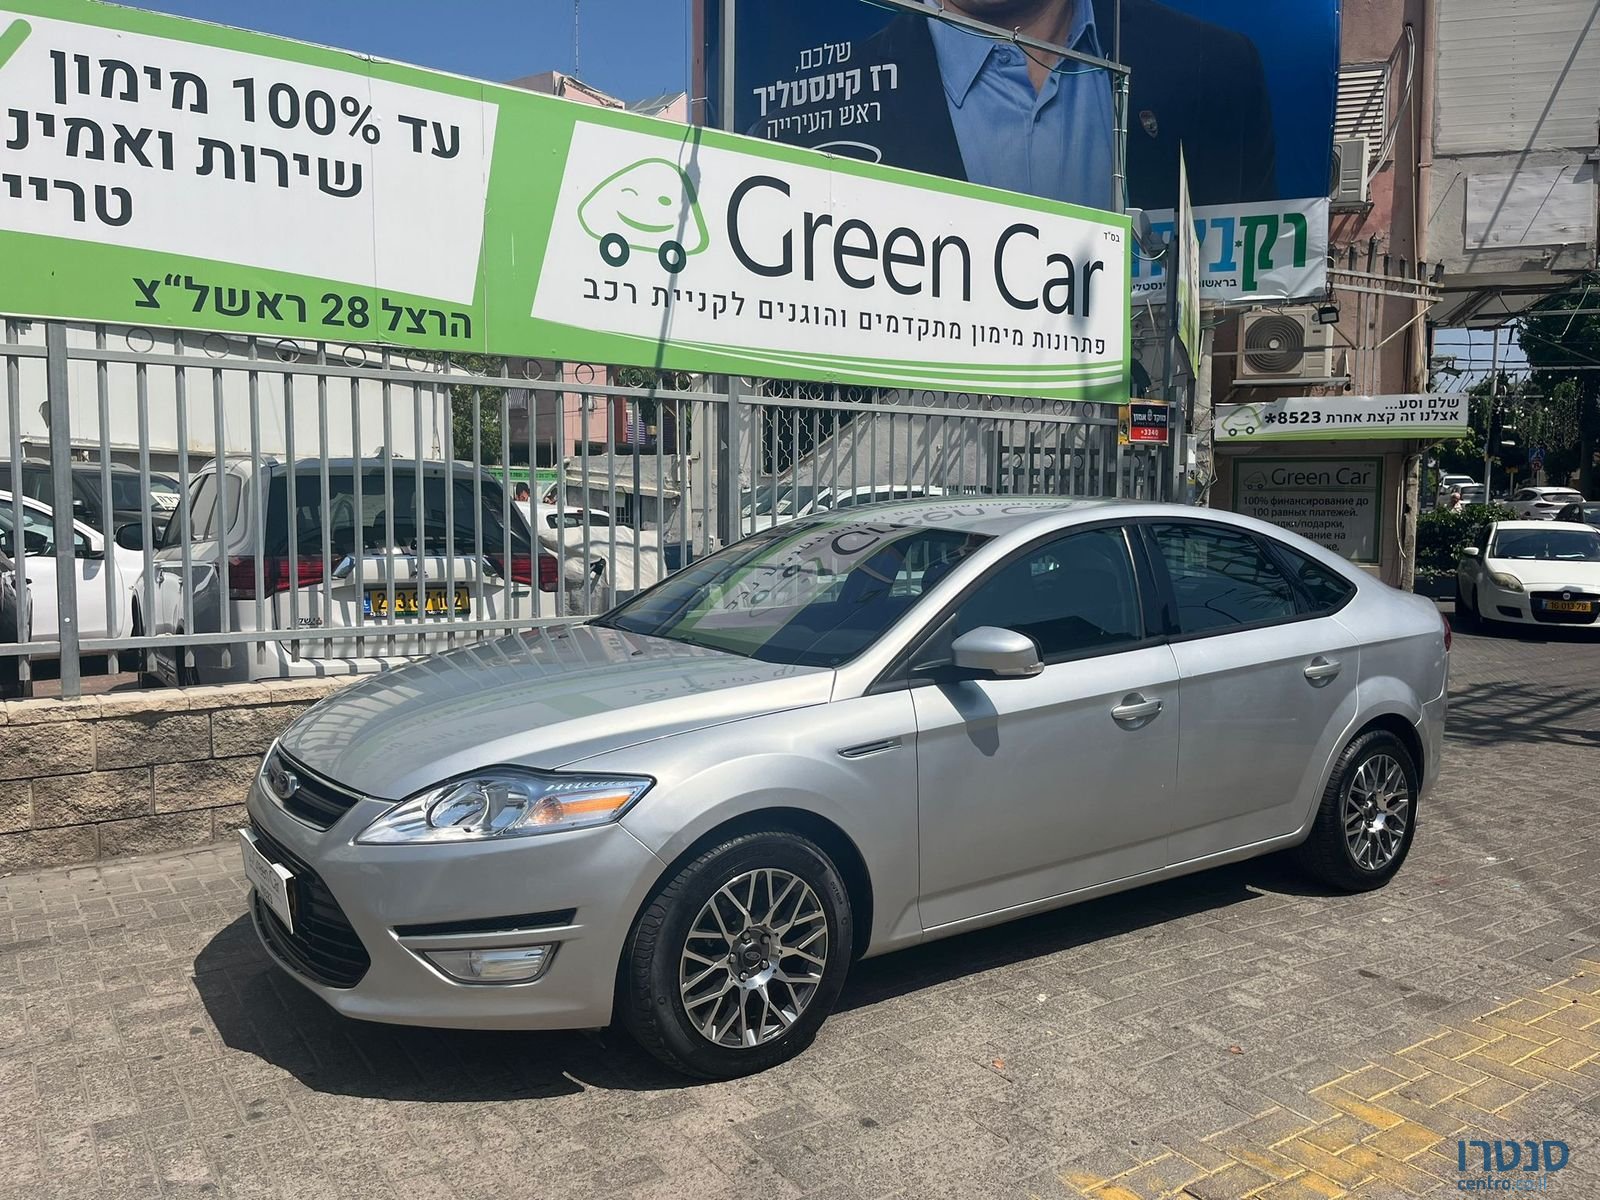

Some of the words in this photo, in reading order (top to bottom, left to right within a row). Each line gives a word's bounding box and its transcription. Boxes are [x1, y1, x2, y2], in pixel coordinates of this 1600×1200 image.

[795, 41, 851, 73] שלכם,
[49, 49, 208, 115] מימון
[753, 67, 862, 117] קינסטליך
[869, 63, 898, 92] רז
[232, 77, 381, 145] 100%
[767, 109, 833, 140] העירייה
[839, 101, 882, 127] ראש
[397, 114, 460, 159] עד
[195, 136, 363, 199] שירות
[726, 175, 972, 303] Green
[994, 223, 1104, 318] Car
[1239, 212, 1308, 292] רק
[583, 277, 638, 304] רכב
[651, 286, 745, 320] לקניית
[320, 293, 370, 329] 28
[380, 297, 472, 340] הרצל
[758, 299, 846, 329] והוגנים
[859, 311, 961, 342] מתקדמים
[971, 324, 1023, 348] מימון
[1032, 331, 1105, 356] פתרונות
[1400, 411, 1415, 422] זה
[1420, 409, 1459, 423] אצלנו
[1428, 396, 1460, 409] שלם
[1326, 413, 1362, 424] אחרת
[1367, 411, 1396, 424] קצת
[1271, 467, 1330, 486] Green
[1336, 467, 1370, 485] Car
[1243, 496, 1269, 506] 100%
[1270, 496, 1354, 509] финансирование
[1355, 496, 1369, 508] до
[1253, 508, 1269, 517] 100
[1271, 508, 1307, 518] равных
[1334, 531, 1346, 540] на
